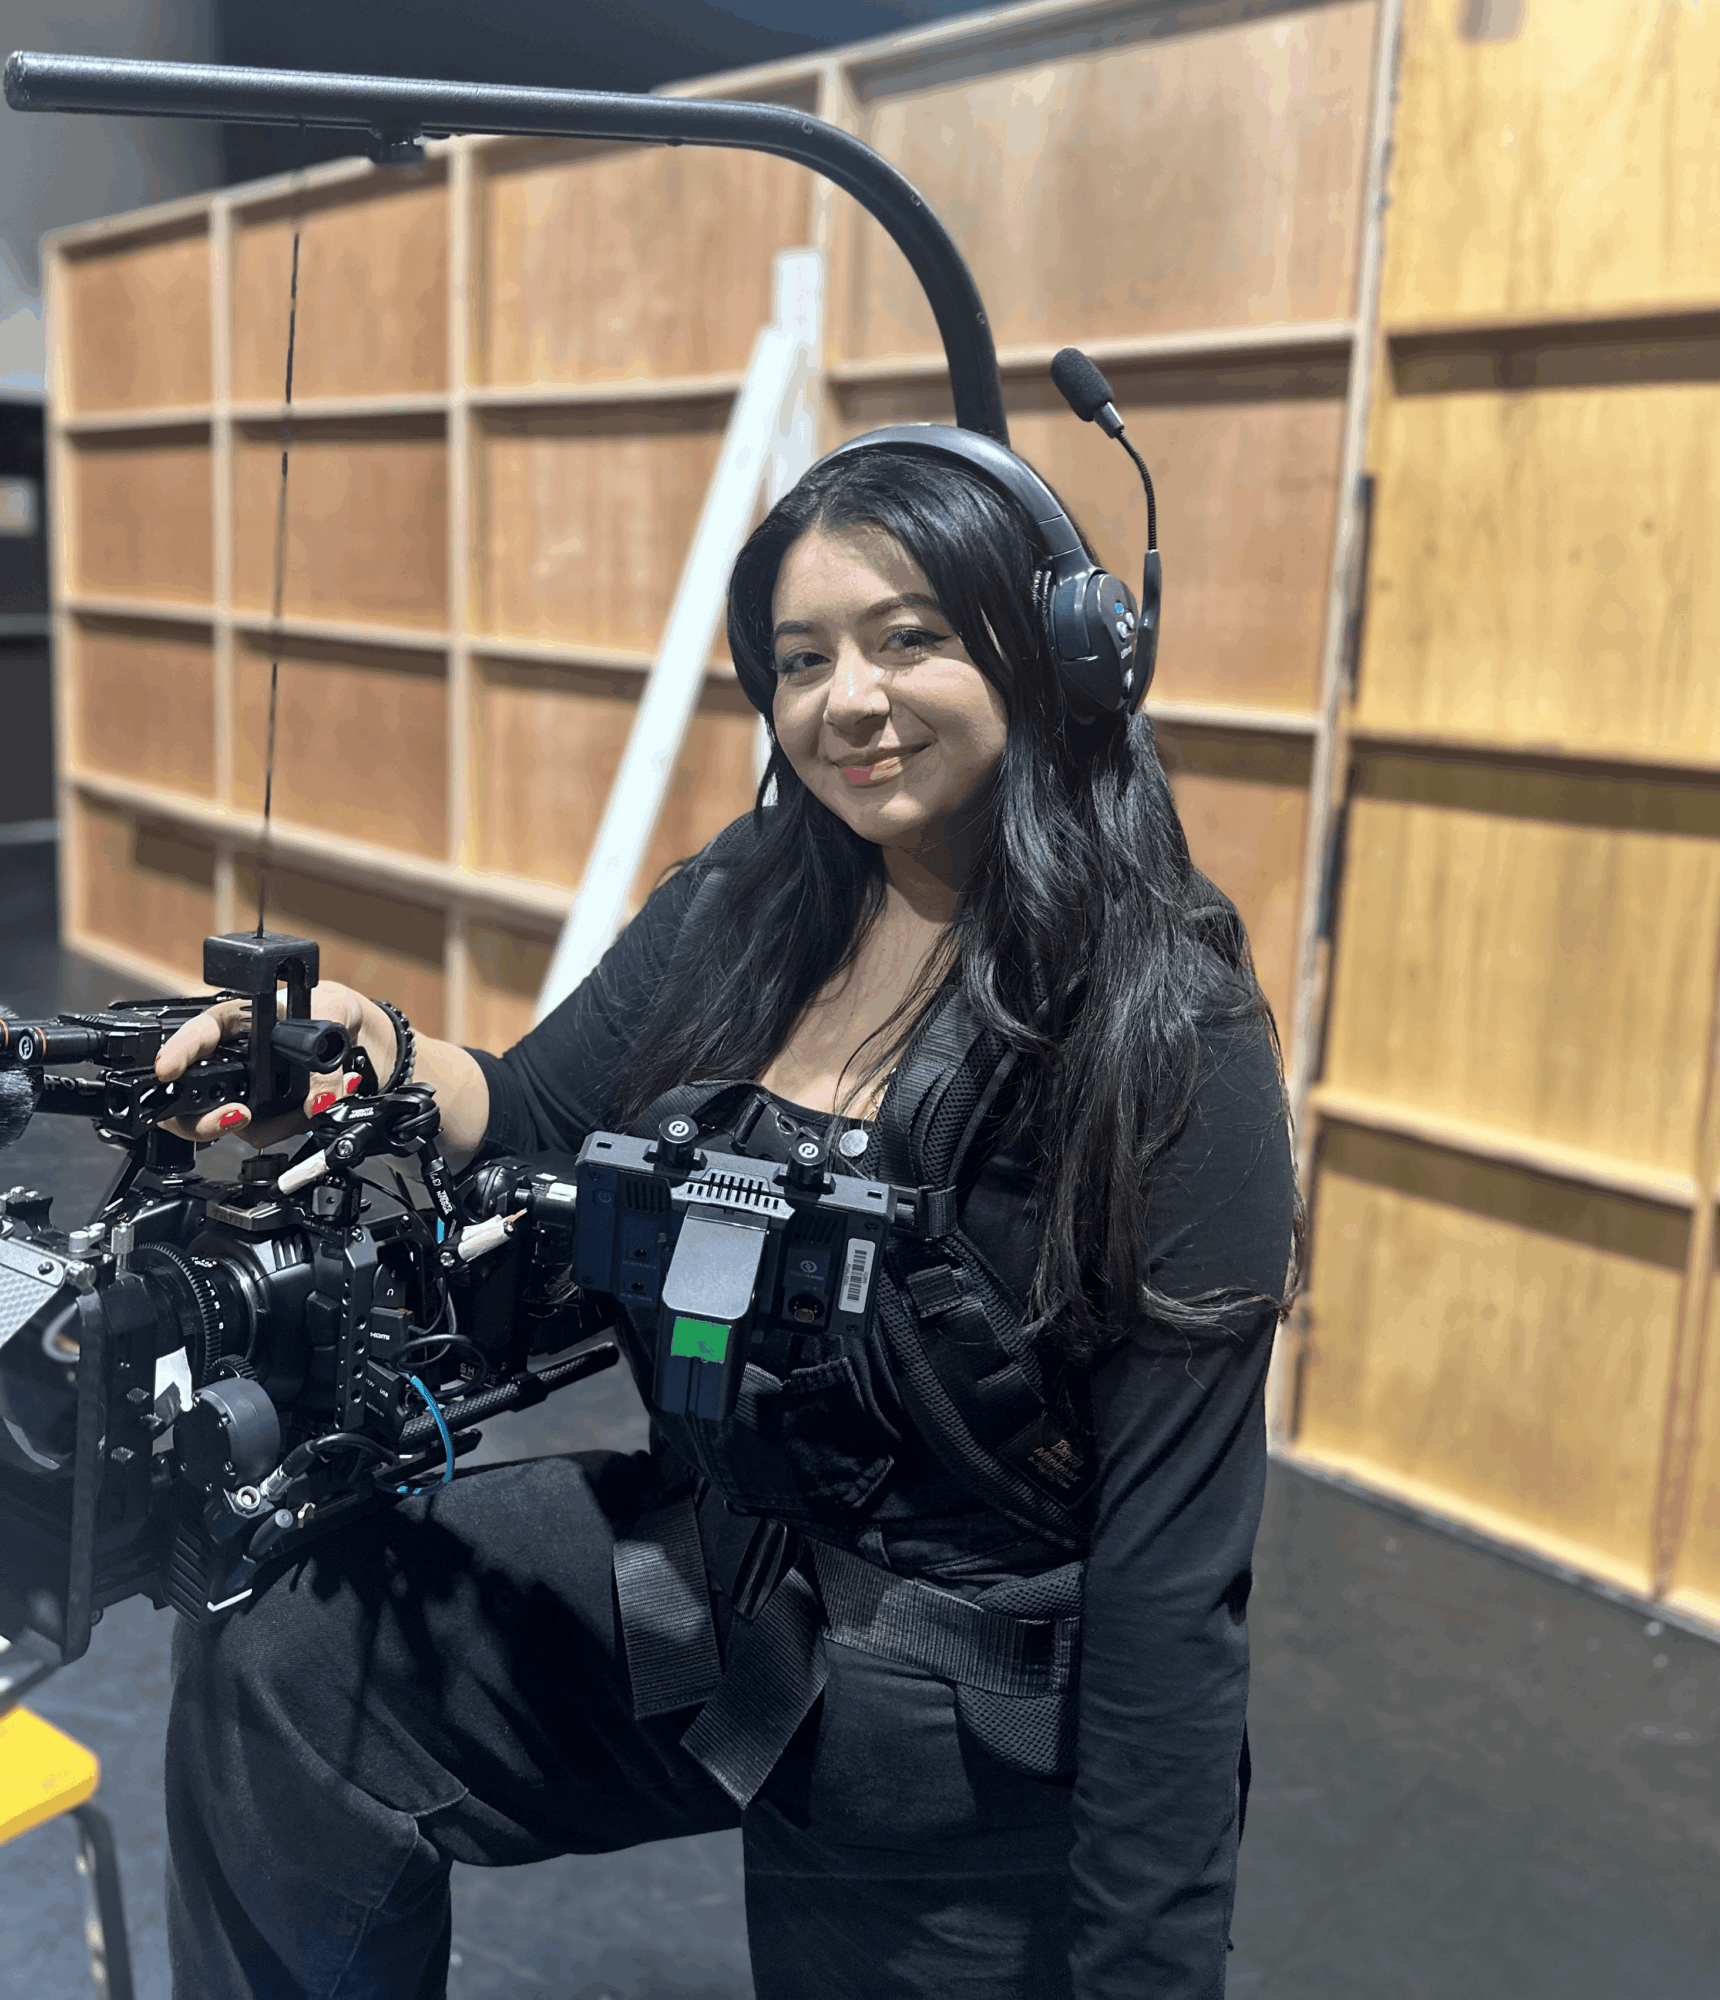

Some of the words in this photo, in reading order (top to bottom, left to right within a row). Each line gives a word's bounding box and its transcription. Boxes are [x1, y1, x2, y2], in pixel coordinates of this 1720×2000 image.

[370, 1331, 391, 1341] HDMI
[460, 1362, 499, 1385] SHE
[1033, 1446, 1081, 1483] Minimax
